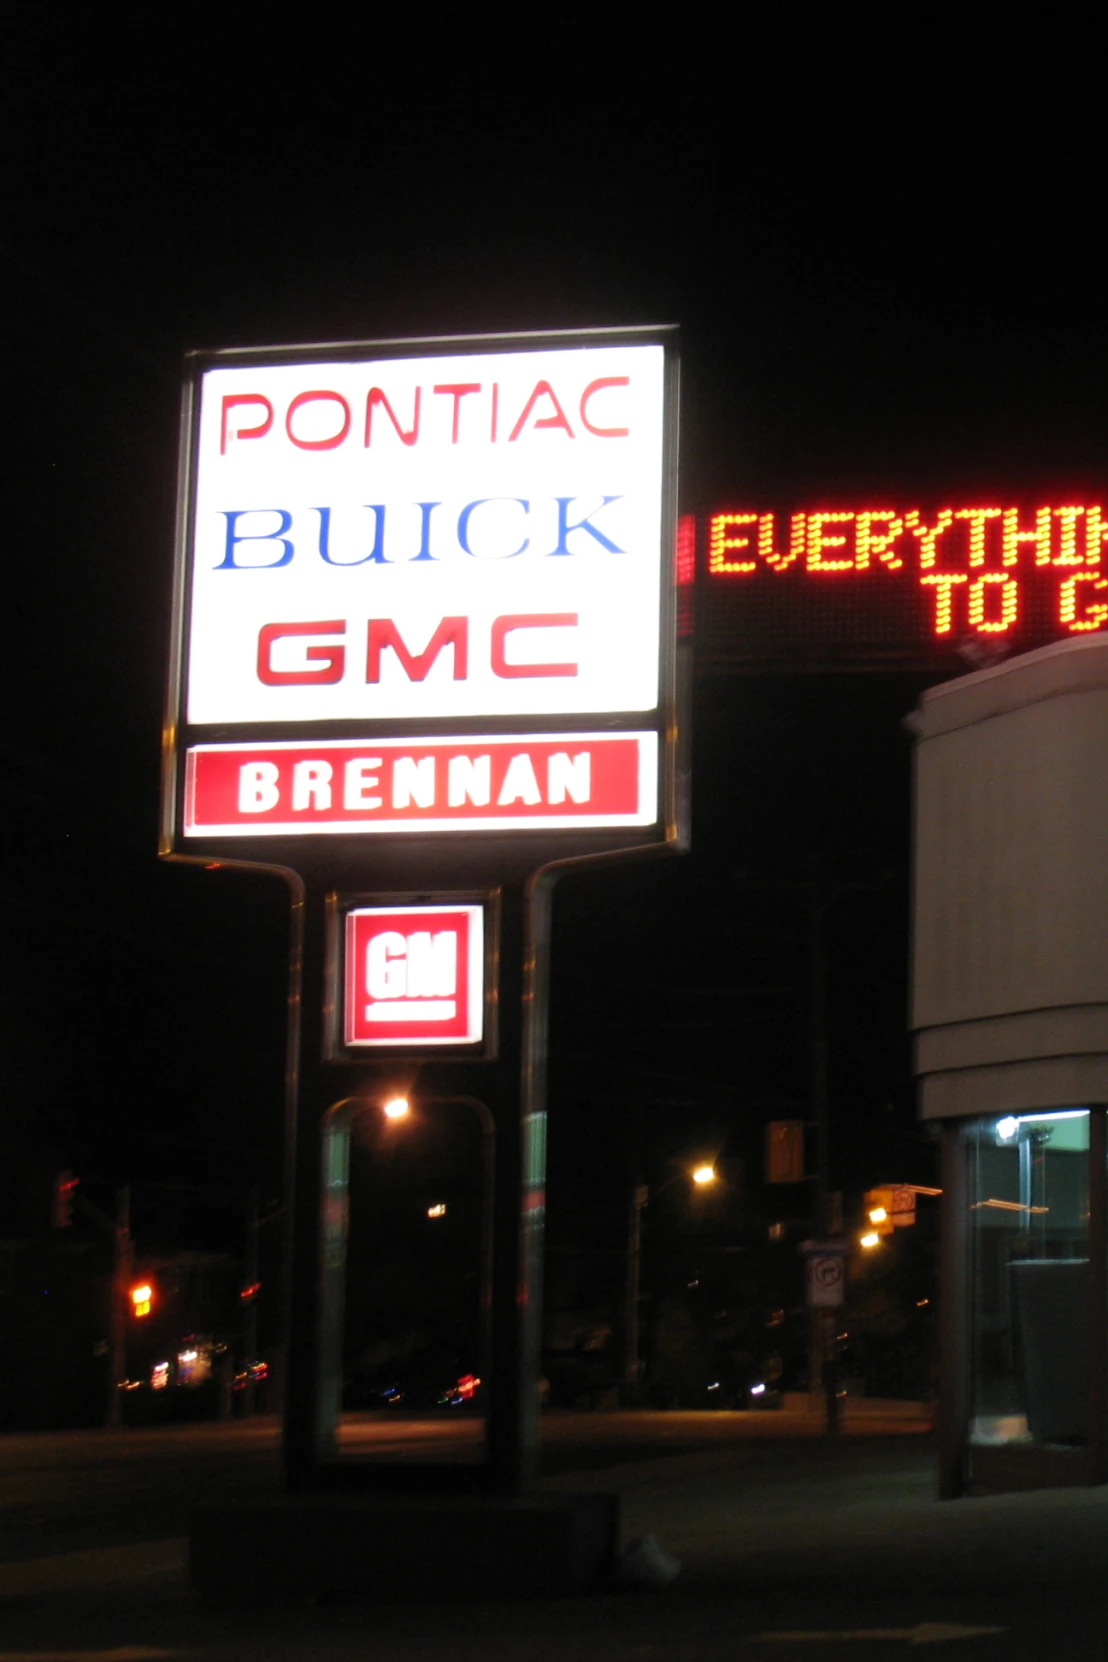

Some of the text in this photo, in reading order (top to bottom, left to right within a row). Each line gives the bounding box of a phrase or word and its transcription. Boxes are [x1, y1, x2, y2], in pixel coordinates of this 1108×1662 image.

[220, 375, 630, 455] PONTIAC
[211, 494, 628, 570] BUICK
[920, 572, 1018, 634] TO
[256, 613, 578, 686] GMC
[237, 752, 591, 814] BRENNAN
[366, 931, 457, 999] GM
